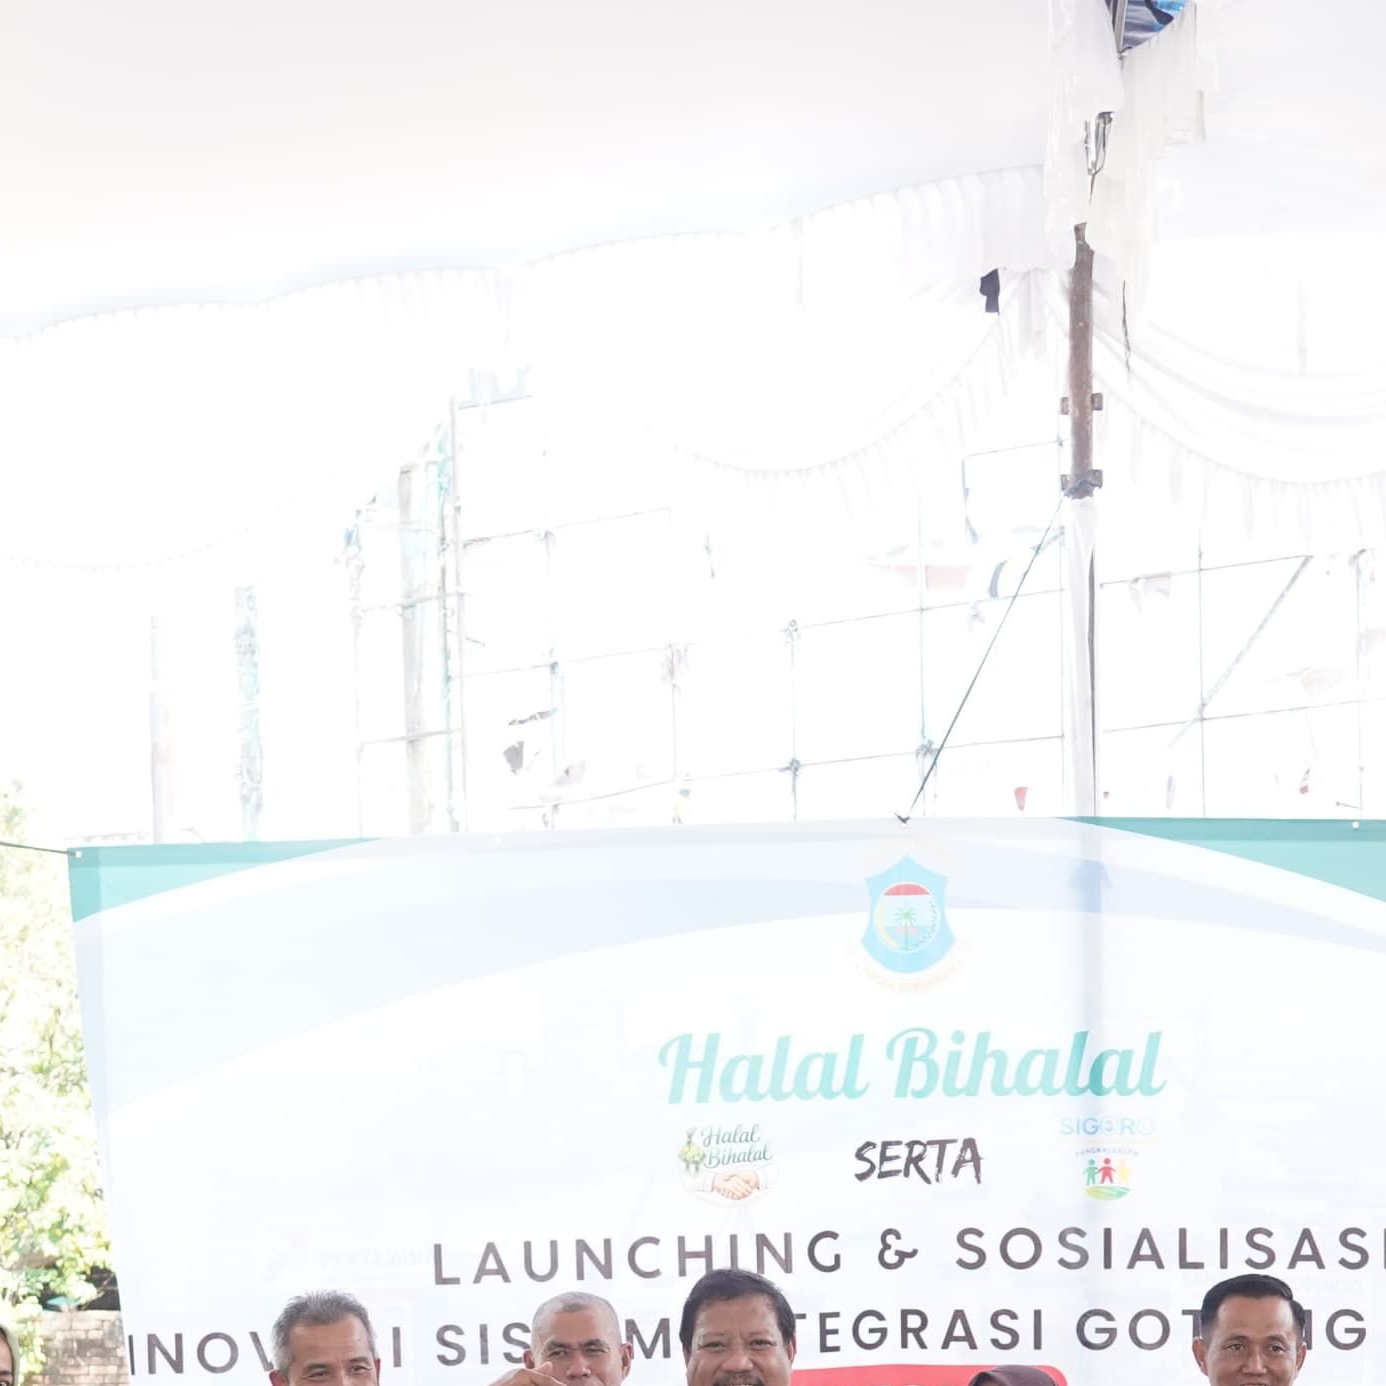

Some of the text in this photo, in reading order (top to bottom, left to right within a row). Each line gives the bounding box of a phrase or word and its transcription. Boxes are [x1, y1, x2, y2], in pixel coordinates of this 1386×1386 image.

[658, 1026, 1169, 1104] Halal Bihalal
[701, 1123, 761, 1148] Halal
[703, 1143, 773, 1169] Bihalal
[853, 1138, 983, 1185] SERTA
[433, 1229, 842, 1285] LAUNCHING
[878, 1228, 918, 1270] &
[128, 1326, 403, 1376] INOVI
[436, 1318, 672, 1366] SISM
[794, 1308, 1043, 1353] EGRASI
[1075, 1308, 1367, 1351] GOTG
